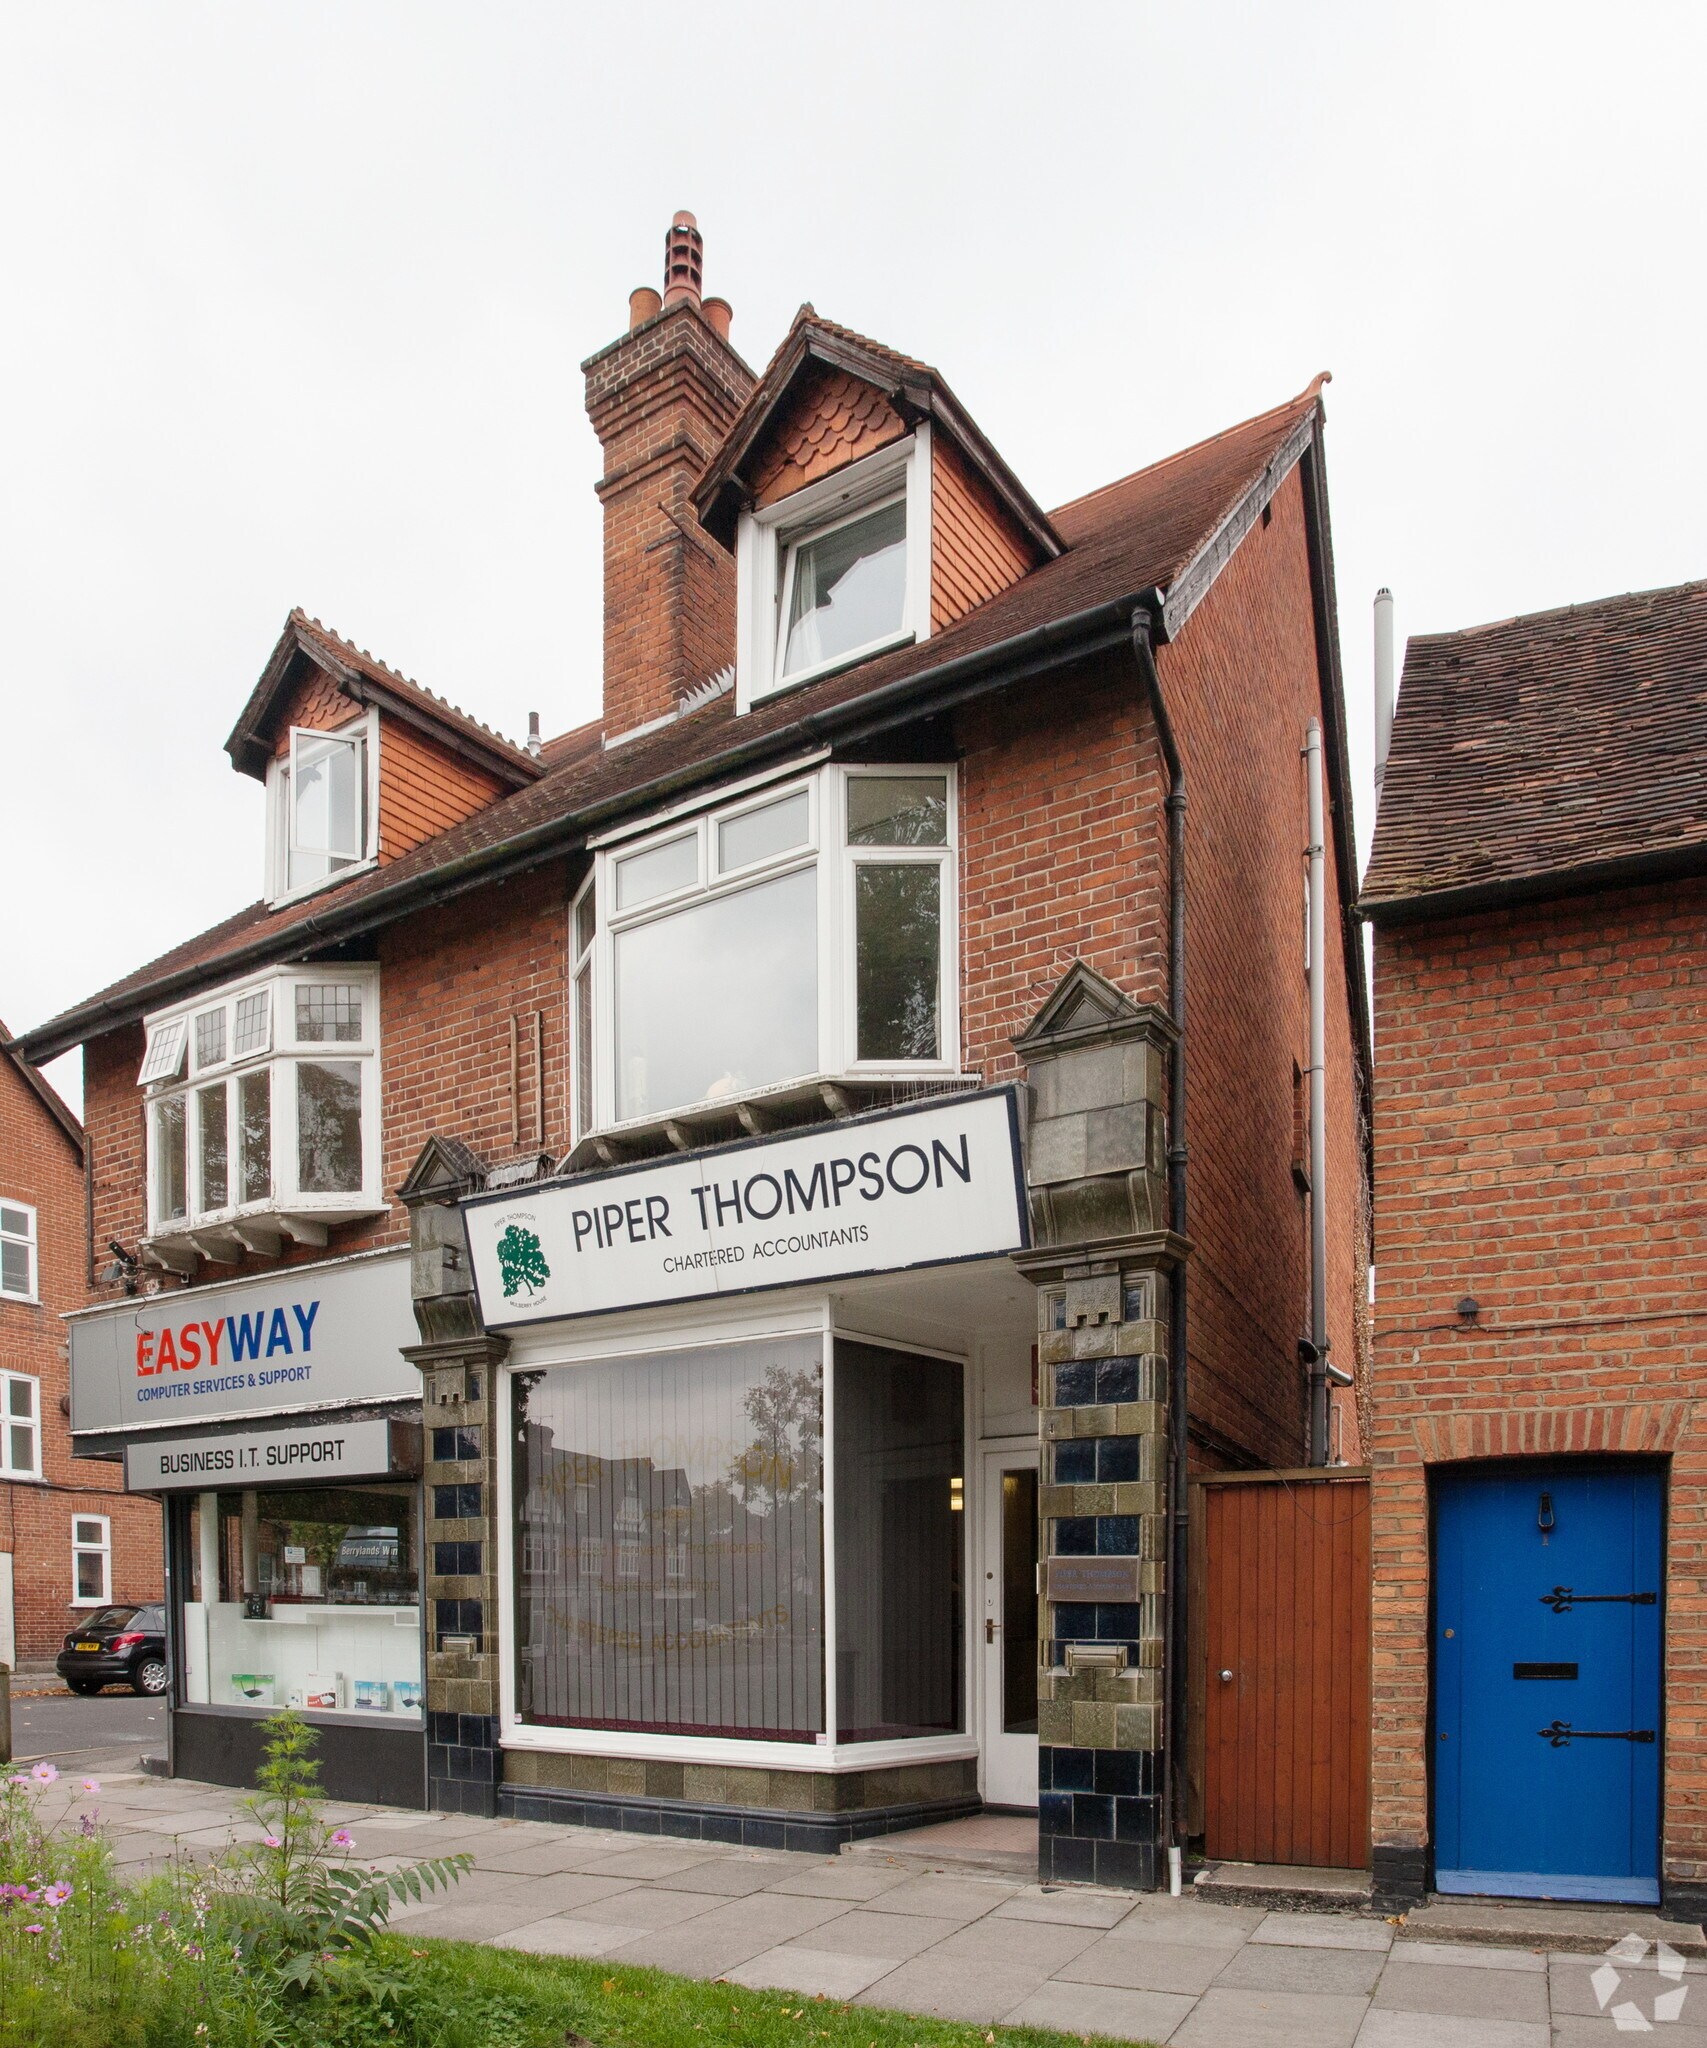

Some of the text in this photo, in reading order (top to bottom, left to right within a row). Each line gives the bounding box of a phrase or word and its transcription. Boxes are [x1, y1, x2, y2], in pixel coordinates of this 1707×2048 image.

[572, 1133, 971, 1253] PIPER THOMPSON
[494, 1212, 536, 1229] PIPER THOMPSON
[663, 1225, 869, 1274] CHARTERED ACCOUNTANTS
[510, 1295, 547, 1309] MULBERRY HOUSE
[137, 1301, 320, 1376] EASYWAY
[137, 1365, 312, 1402] COMPUTER SERVICES & SUPPORT
[160, 1439, 345, 1475] BUSINESS I.T. SUPPORT
[341, 1546, 380, 1557] Berrylands
